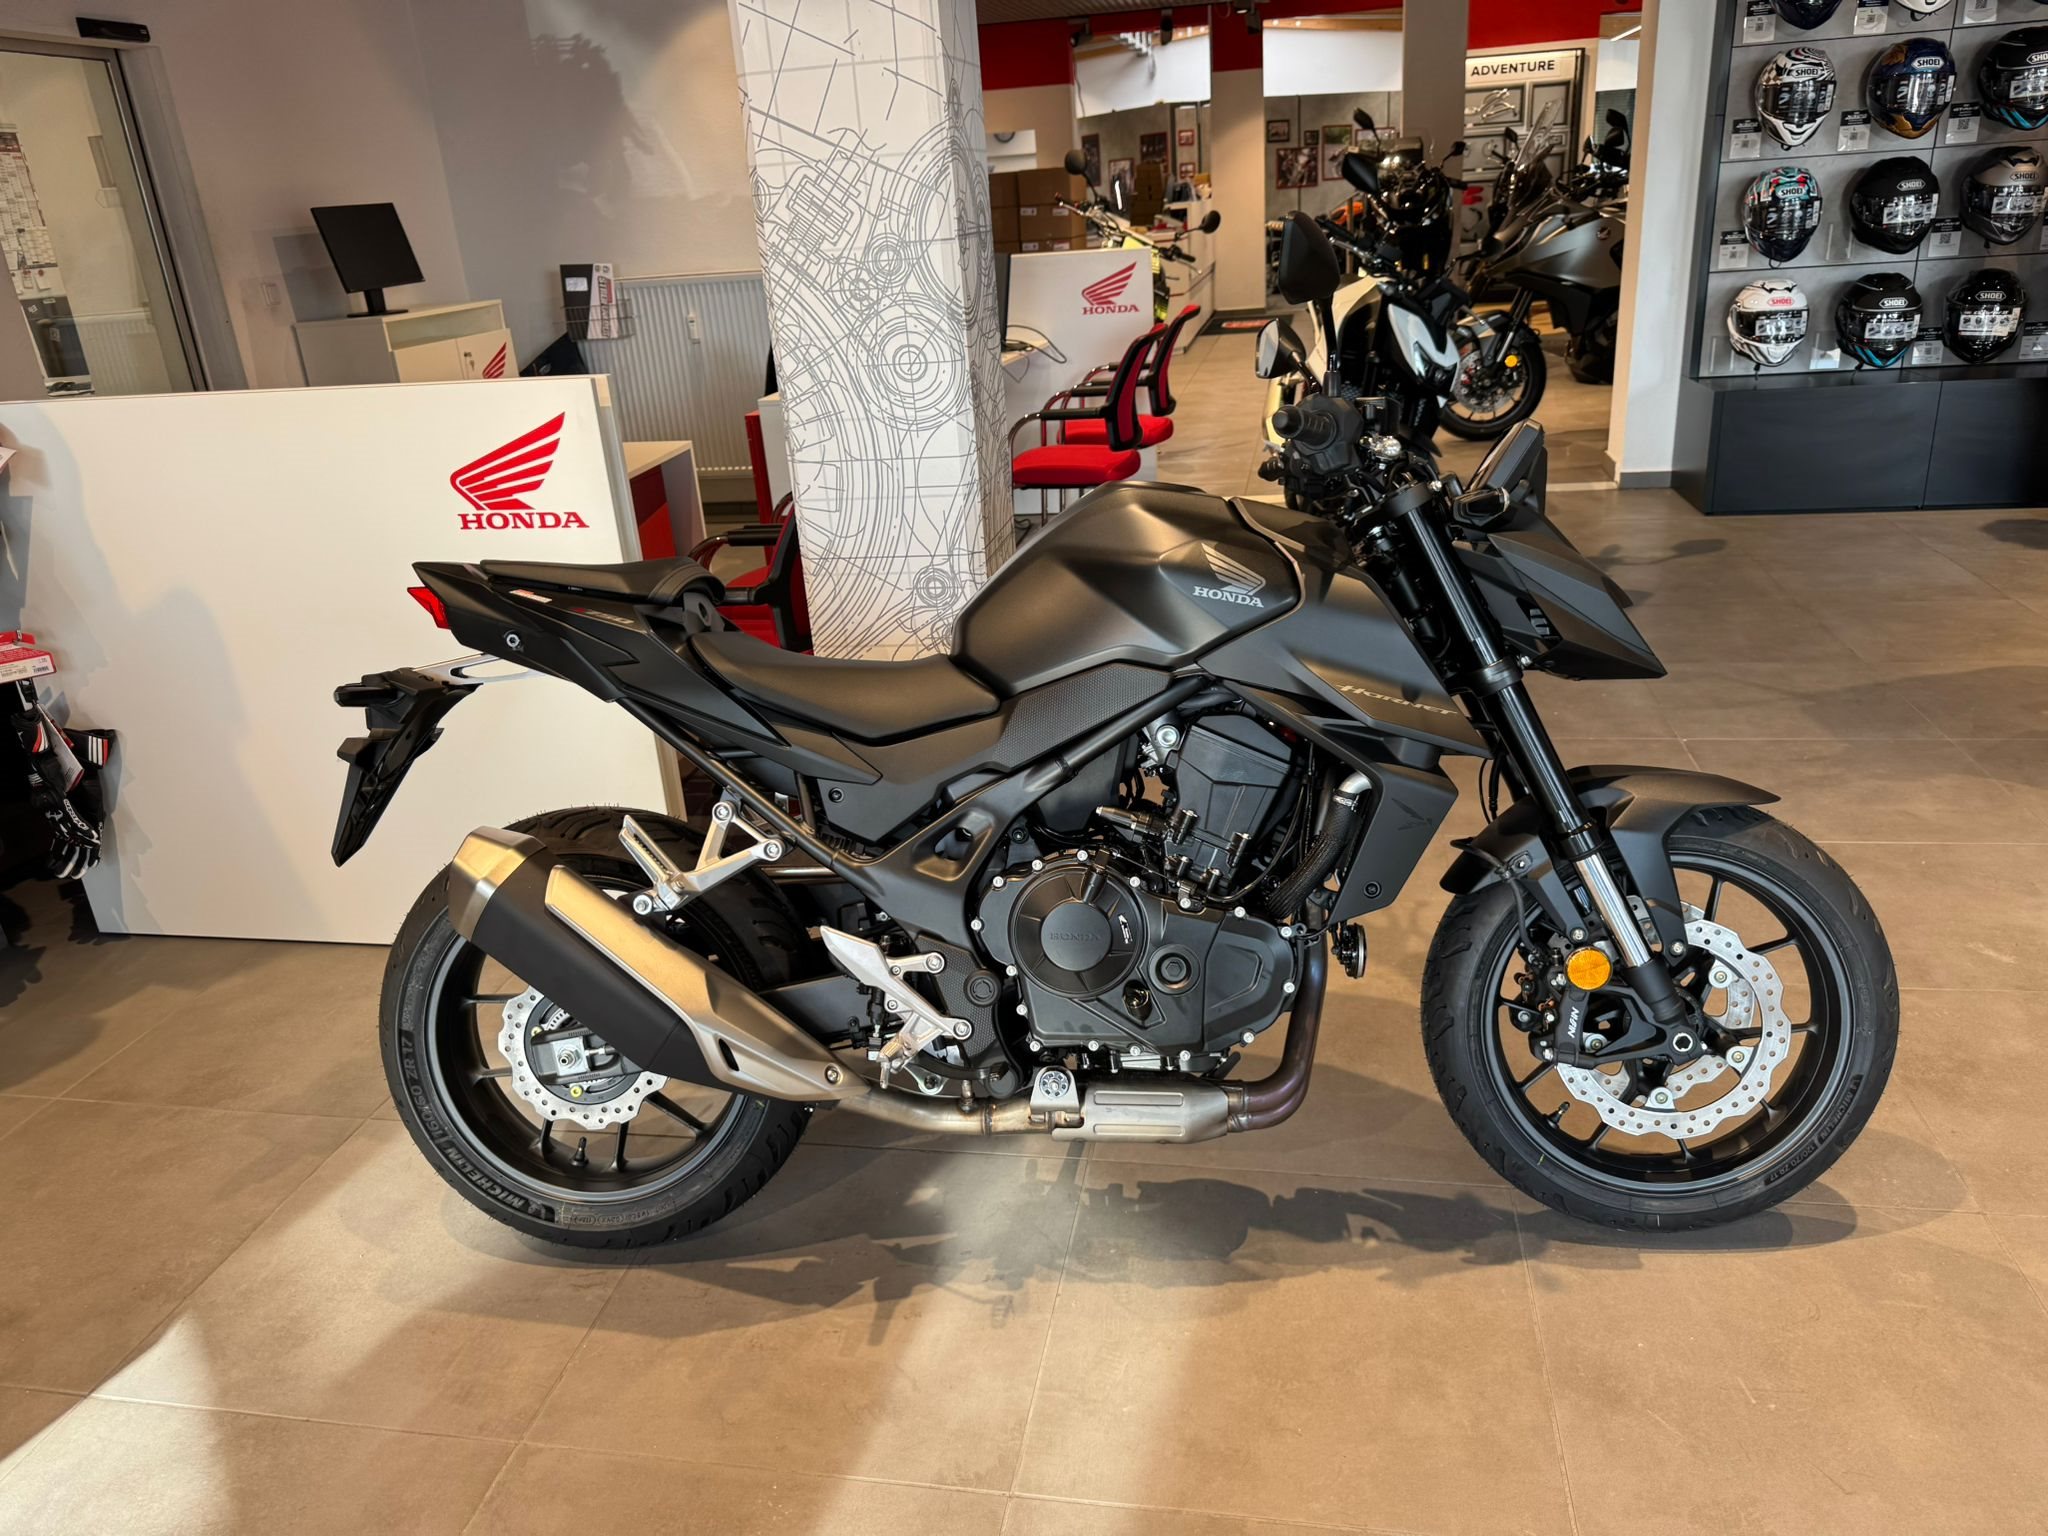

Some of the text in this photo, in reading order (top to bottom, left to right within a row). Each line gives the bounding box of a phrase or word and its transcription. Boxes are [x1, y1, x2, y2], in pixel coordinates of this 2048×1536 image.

[1470, 59, 1556, 77] ADVENTURE
[1917, 58, 1941, 67] SHOEI
[1795, 67, 1819, 77] SHOEI
[2014, 172, 2036, 180] SHOEI
[1901, 181, 1923, 190] SHOEI
[1780, 187, 1804, 196] SHOEI
[1771, 297, 1792, 306] SHOEI
[1979, 292, 2003, 300] SHOEI
[1883, 299, 1905, 307] SHOEI
[1082, 304, 1140, 315] HONDA
[457, 511, 590, 530] HONDA
[1192, 585, 1265, 608] HONDA
[1050, 931, 1102, 943] HONDA
[401, 1037, 415, 1053] 17
[403, 1058, 419, 1080] ZR
[1820, 1091, 1853, 1139] MICHELIN
[444, 1146, 527, 1210] MICHELIN
